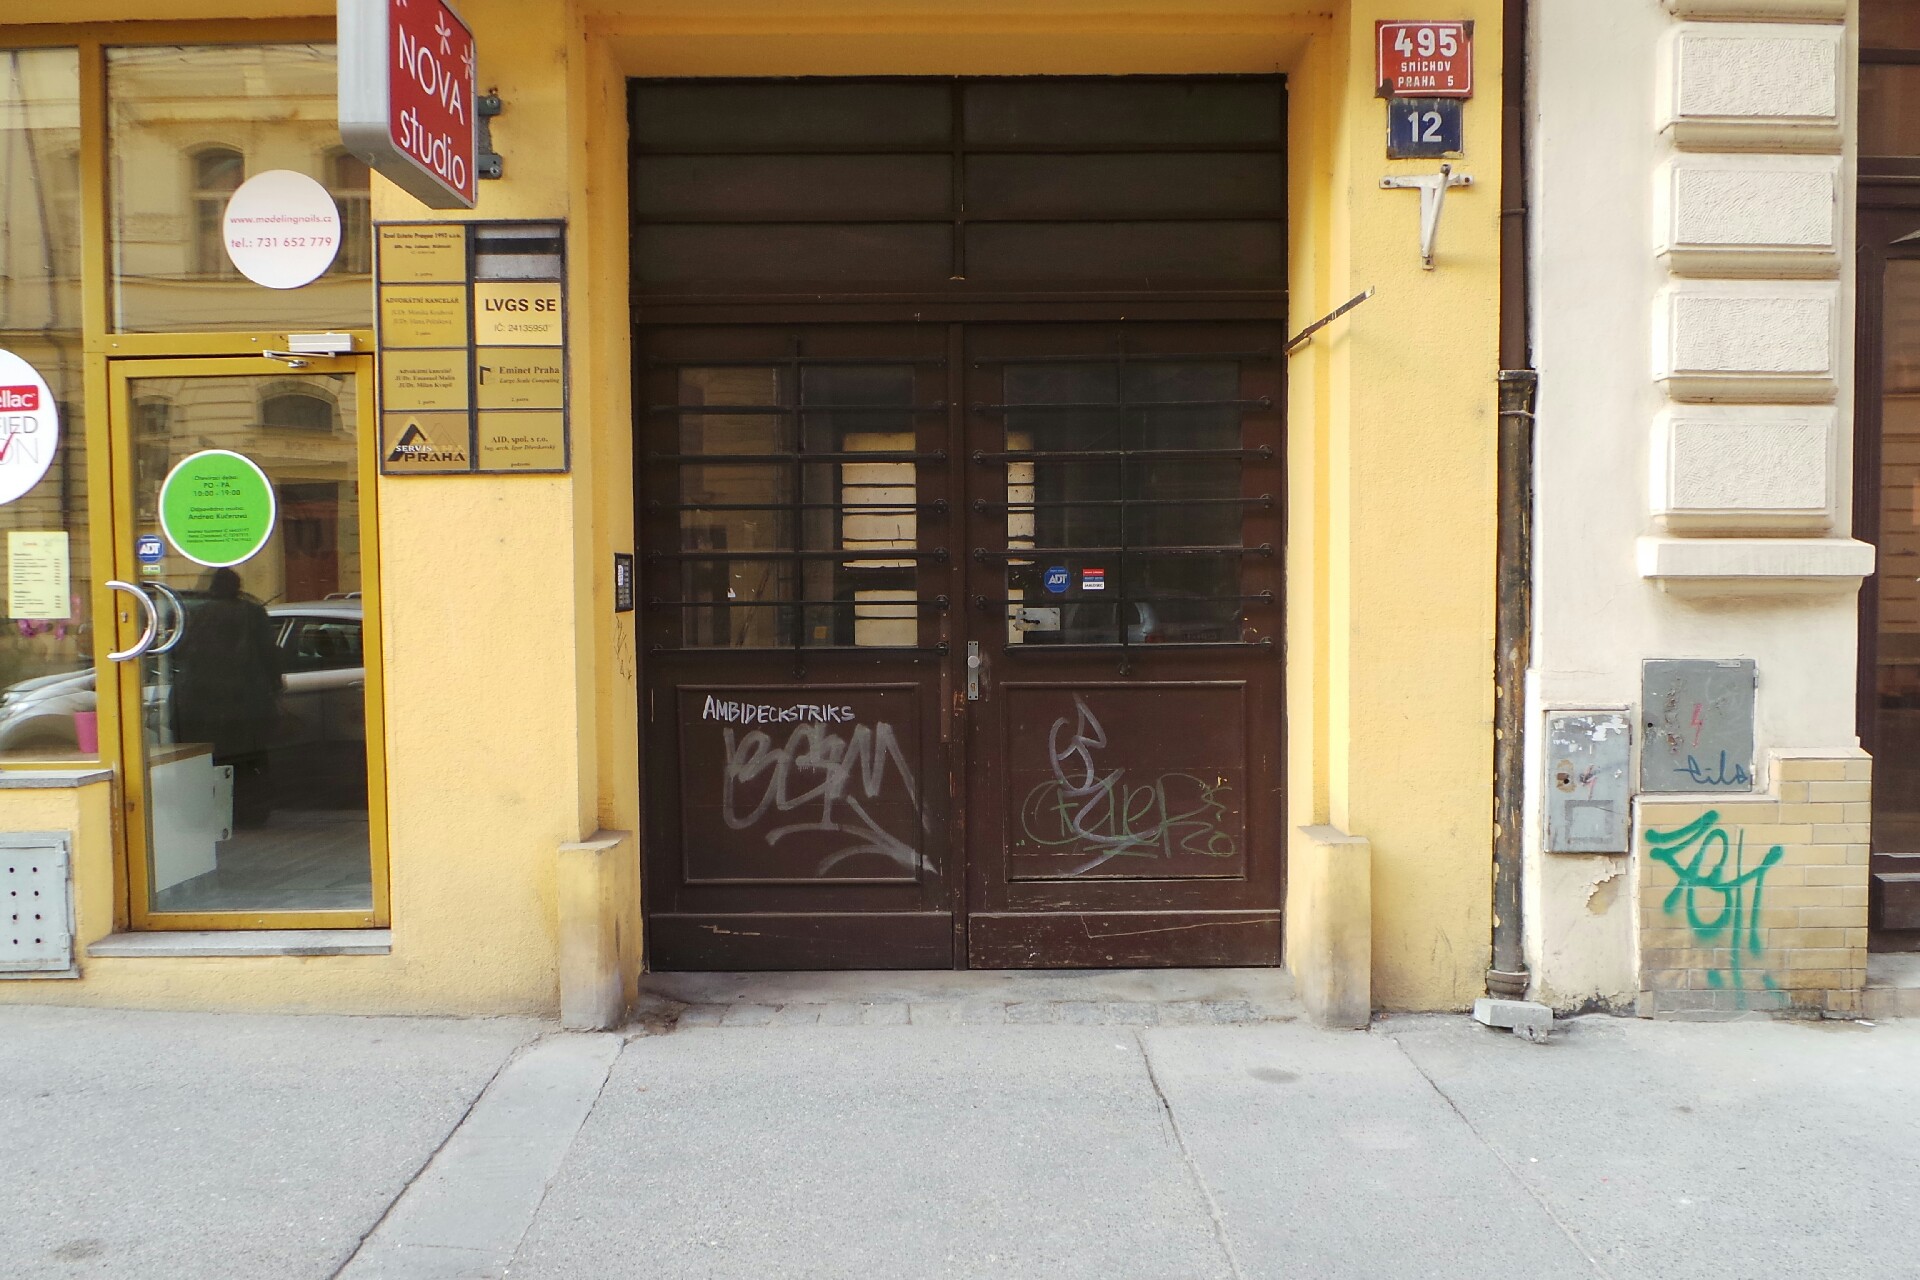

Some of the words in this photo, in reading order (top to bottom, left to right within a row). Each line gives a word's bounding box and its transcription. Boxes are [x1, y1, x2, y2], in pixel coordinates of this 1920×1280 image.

[1394, 27, 1458, 57] 495
[399, 23, 465, 126] NOVA
[1398, 76, 1436, 88] PRAHA
[1447, 75, 1454, 87] 5
[1407, 111, 1443, 143] 12
[400, 106, 467, 190] studio
[230, 214, 332, 225] www.modelingnails.cz
[231, 238, 253, 248] tel.:
[257, 237, 278, 248] 731
[283, 237, 306, 247] 652
[310, 237, 332, 247] 779
[484, 298, 529, 312] LVGS
[534, 298, 556, 312] SE
[499, 366, 531, 374] Eminet
[534, 366, 560, 374] Praha
[404, 452, 466, 462] PRAHA
[140, 543, 160, 554] ADT
[1048, 574, 1067, 584] ADT
[702, 694, 856, 724] AMBIDECKSTRIKS
